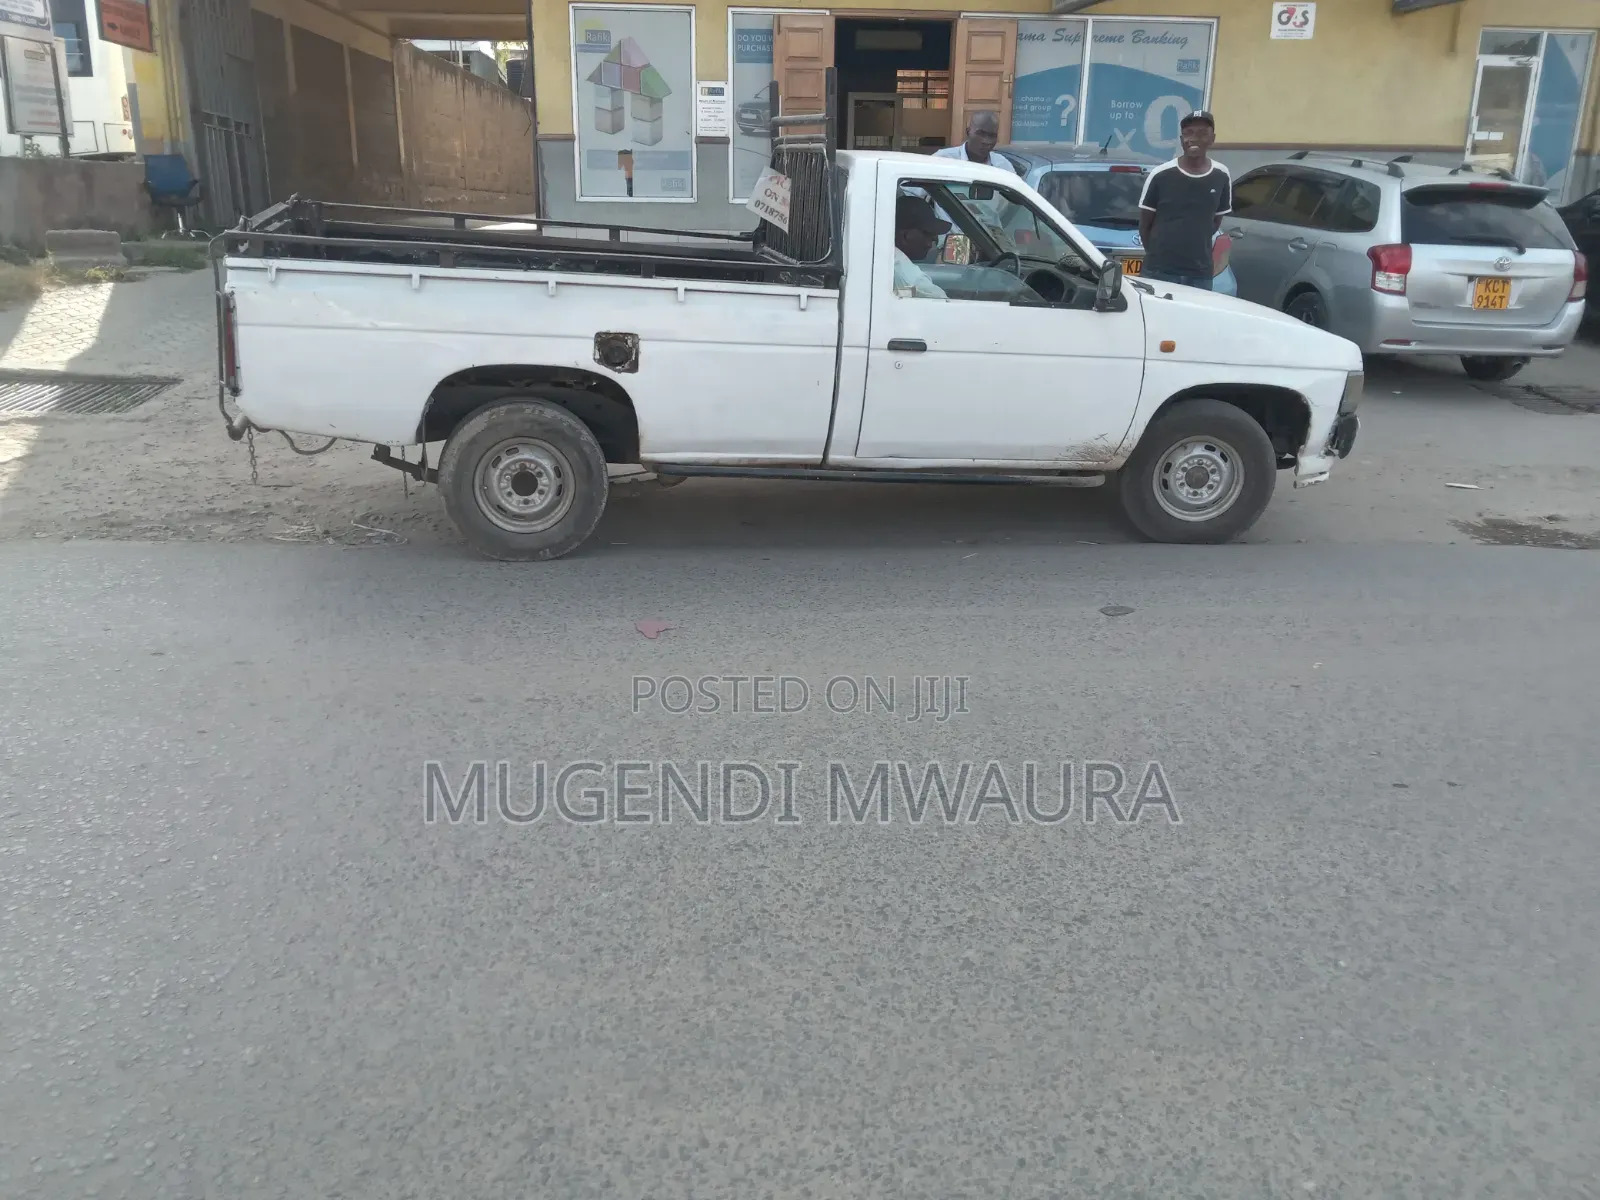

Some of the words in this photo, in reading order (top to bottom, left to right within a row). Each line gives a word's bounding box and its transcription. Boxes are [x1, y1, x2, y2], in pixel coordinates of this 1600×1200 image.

[1277, 6, 1309, 28] G4S
[1131, 29, 1189, 50] Banking
[1111, 100, 1143, 109] Borrow
[1110, 112, 1122, 120] up
[1125, 111, 1135, 119] to
[1477, 295, 1506, 308] 914T
